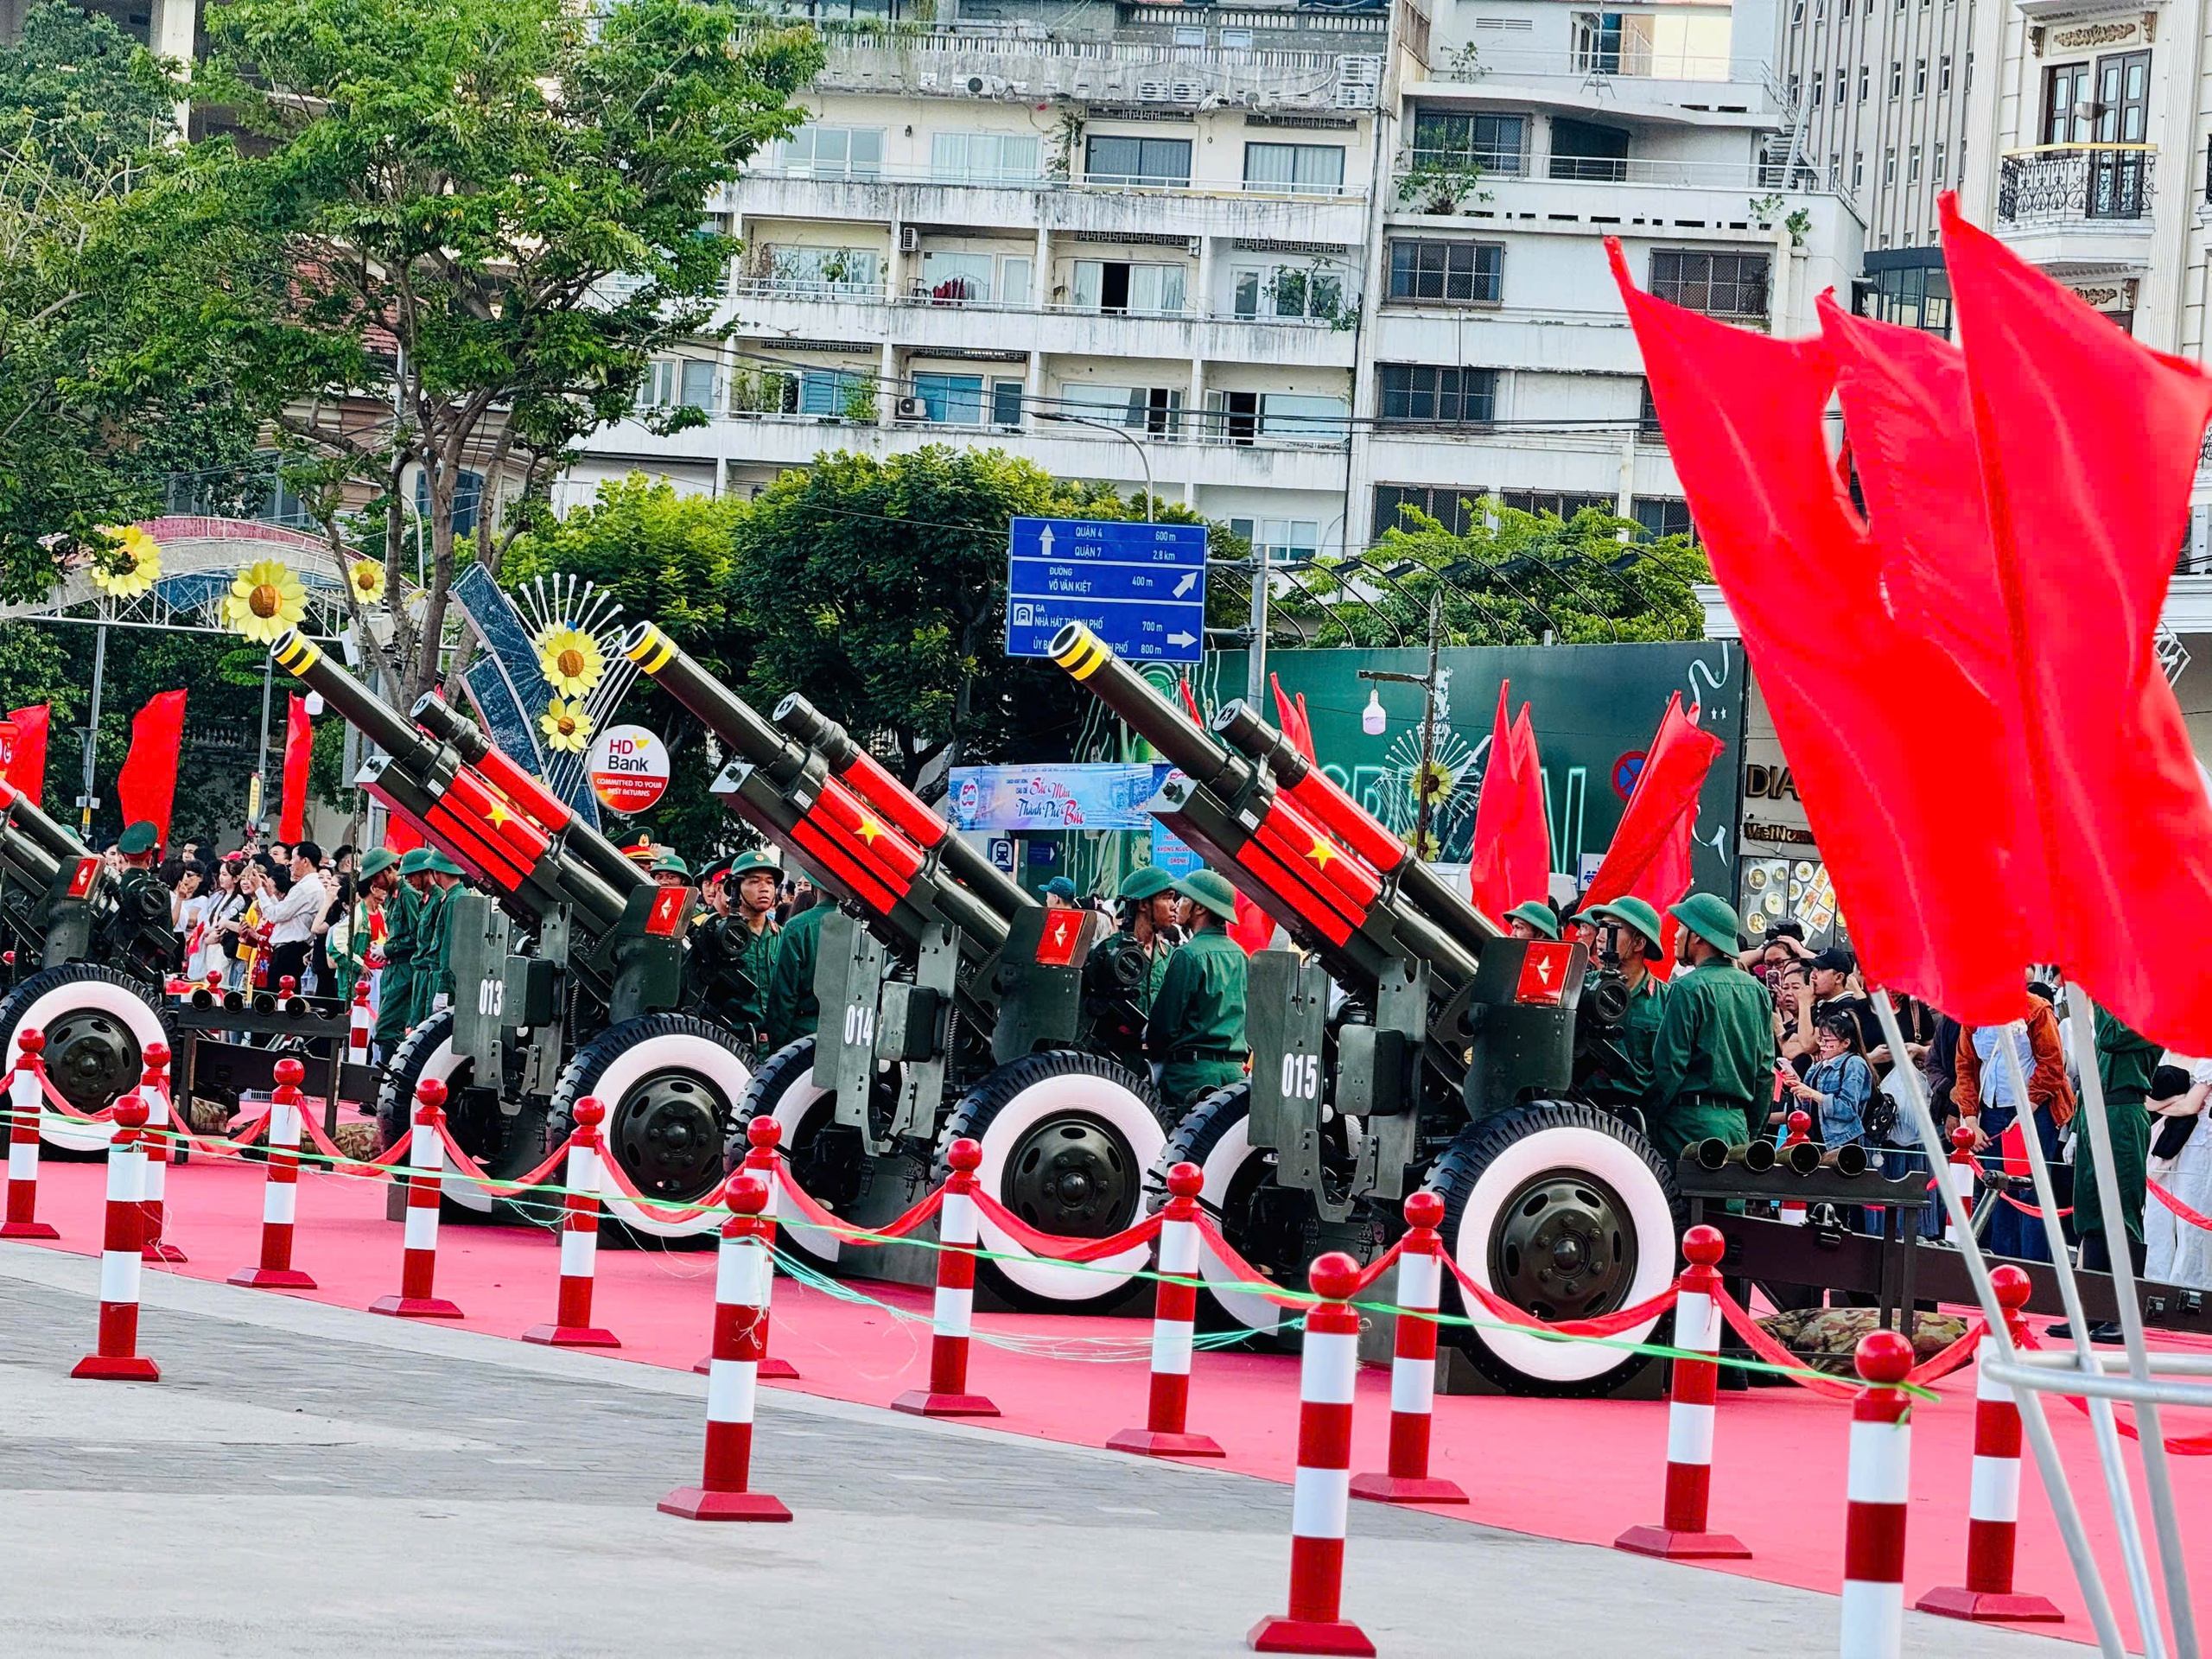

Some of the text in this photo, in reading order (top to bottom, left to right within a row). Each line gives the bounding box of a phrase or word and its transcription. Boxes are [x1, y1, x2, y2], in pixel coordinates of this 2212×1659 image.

[1075, 525, 1103, 540] QUẬN 4
[1155, 531, 1176, 542] 600 m
[1074, 544, 1102, 558] QUẬN 7
[1164, 550, 1175, 561] km
[1048, 578, 1091, 594] VÕ VĂN KIỆT
[1132, 575, 1145, 587] 400
[1035, 604, 1046, 613] GA
[1034, 614, 1049, 627] NHÀ
[1050, 615, 1064, 628] HÁT
[1089, 616, 1104, 630] PHỐ
[1142, 620, 1155, 632] 700
[1115, 640, 1129, 653] PHỐ
[1141, 644, 1162, 655] 800 m
[609, 739, 633, 754] HD
[607, 754, 649, 772] Bank
[596, 778, 633, 787] COMMITTED
[622, 788, 650, 797] RETURNS
[1015, 798, 1042, 817] Thành
[1060, 799, 1085, 826] Bác
[479, 978, 503, 1017] 013
[844, 1004, 874, 1047] 014
[1281, 1052, 1318, 1100] 015
